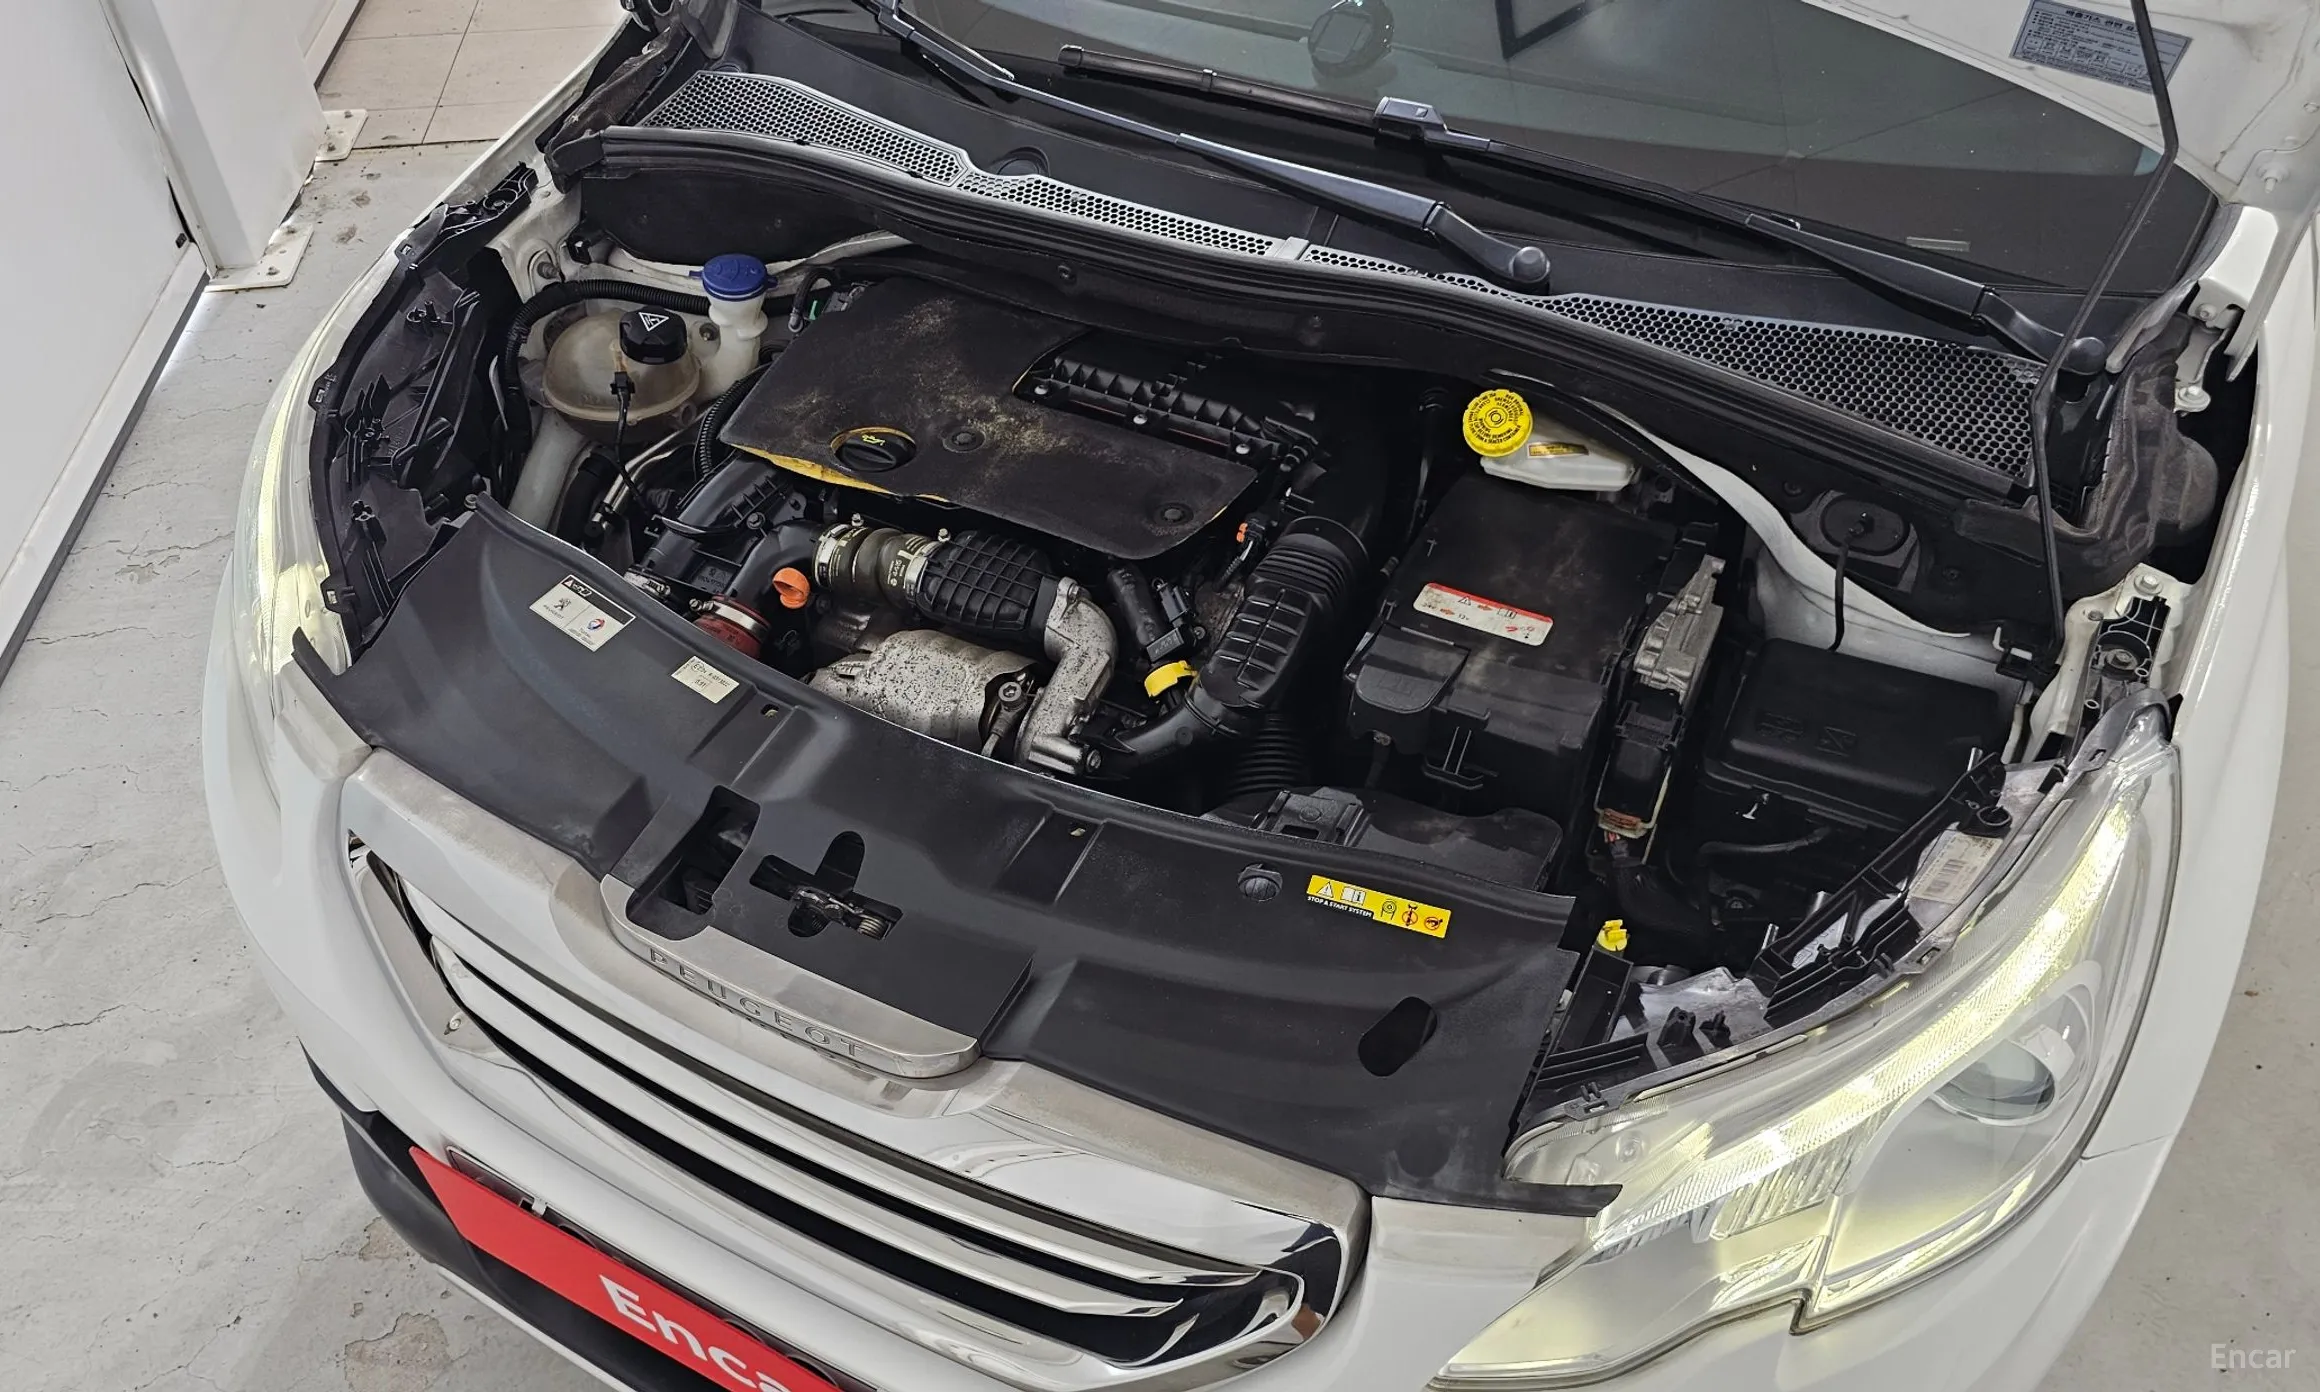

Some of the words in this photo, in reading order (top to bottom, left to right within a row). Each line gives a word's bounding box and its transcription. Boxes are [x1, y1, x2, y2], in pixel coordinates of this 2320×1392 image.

[1307, 896, 1323, 904] STOP
[1329, 902, 1348, 910] START
[1349, 907, 1372, 917] SYSTEM
[650, 948, 864, 1057] PEUGEOT
